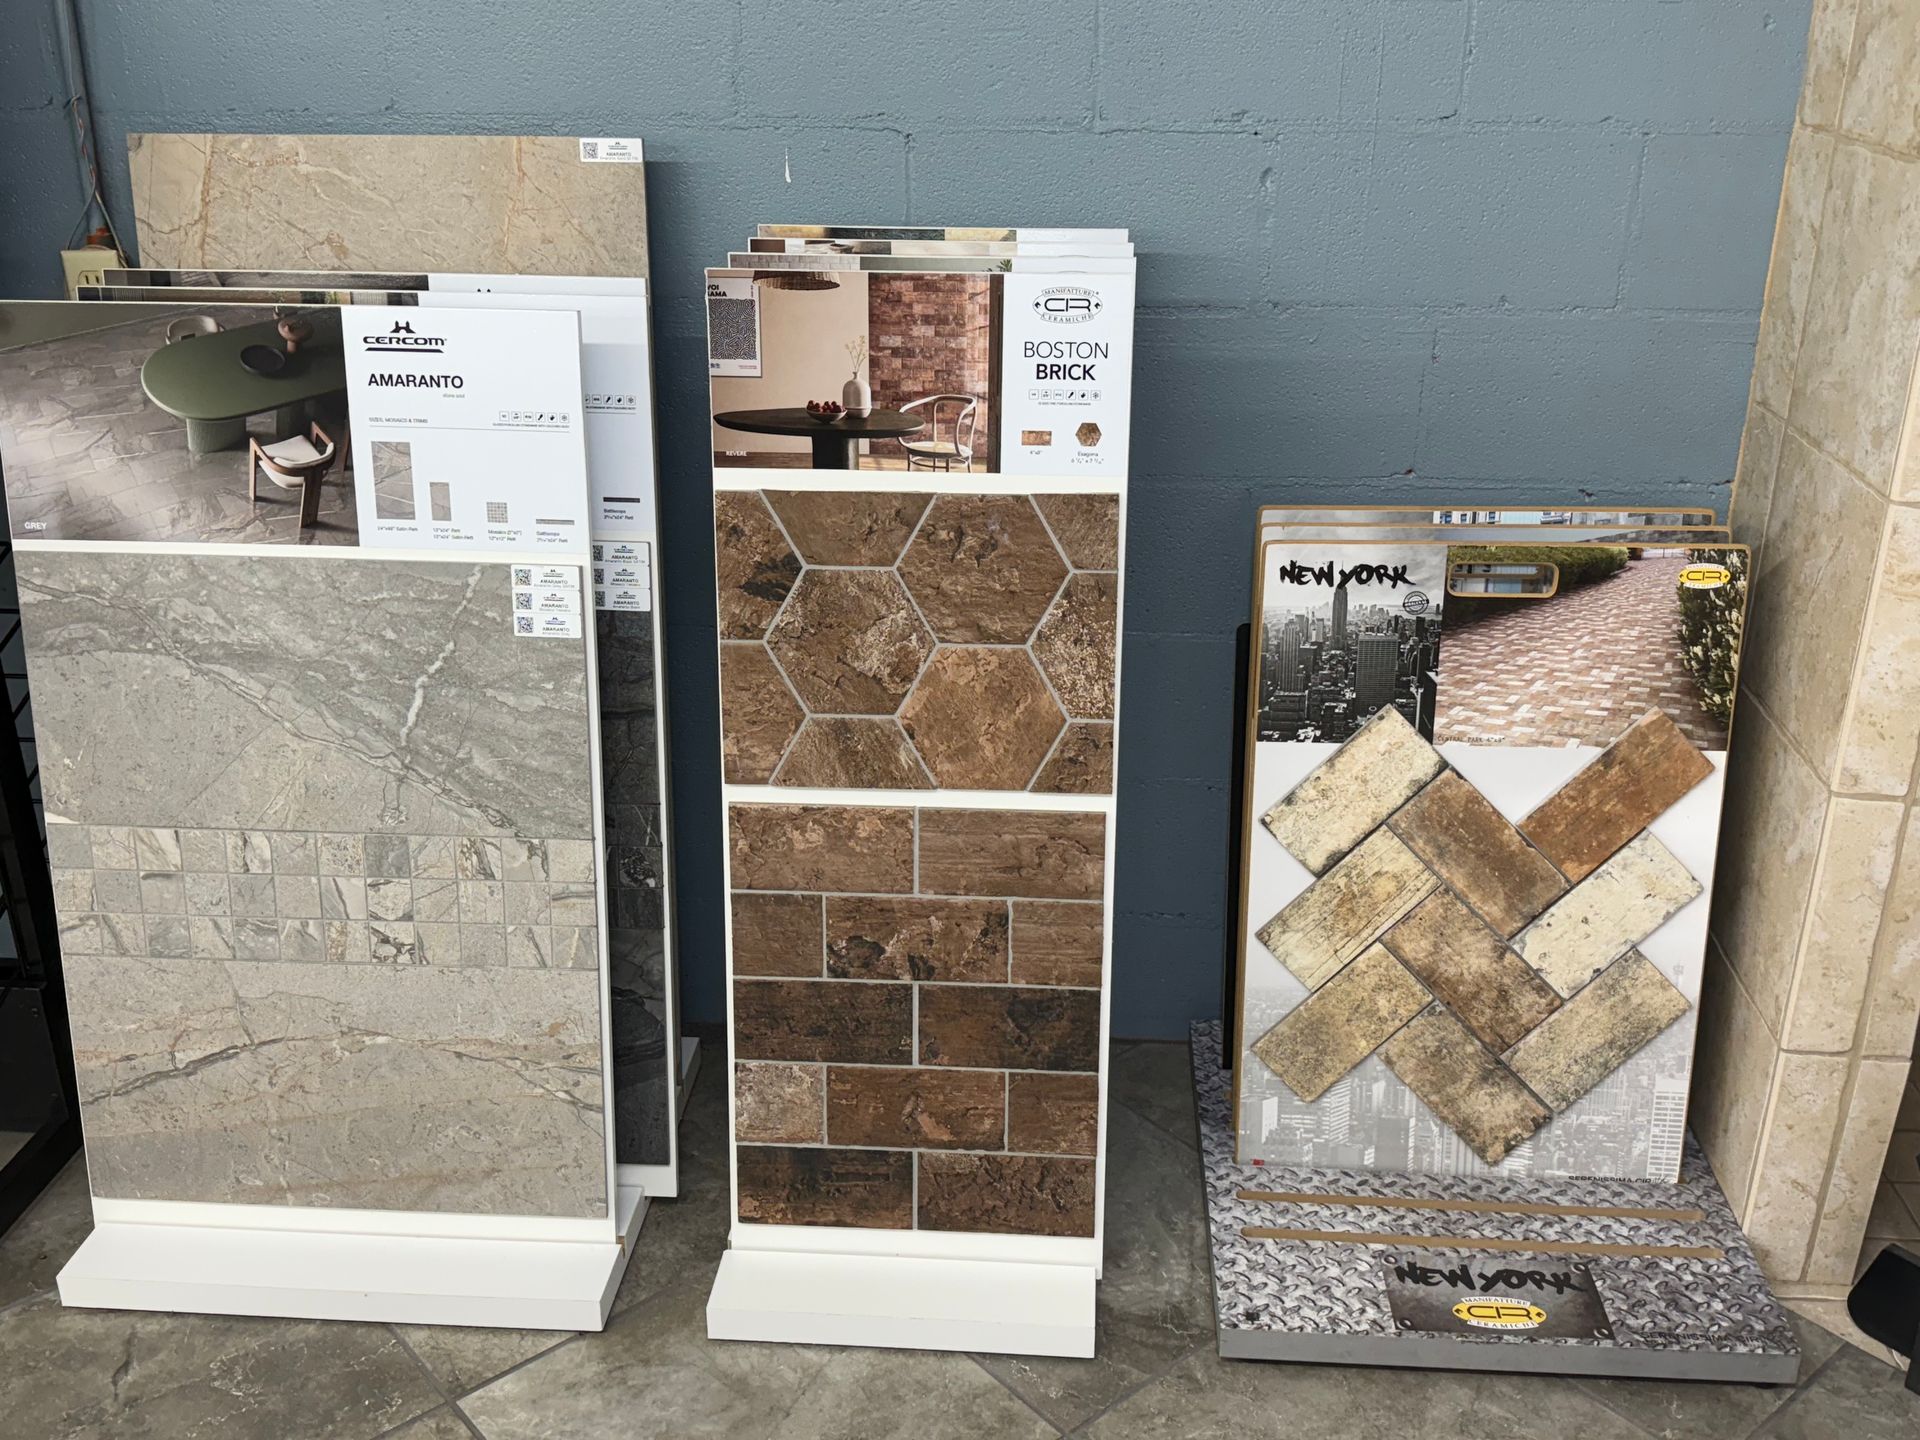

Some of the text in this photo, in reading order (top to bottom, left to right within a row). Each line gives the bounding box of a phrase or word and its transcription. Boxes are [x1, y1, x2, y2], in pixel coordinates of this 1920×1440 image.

[1044, 287, 1094, 297] MANIFATTURE
[1042, 313, 1092, 323] CERAMICHE
[362, 336, 445, 346] CERCOM
[1024, 341, 1108, 359] BOSTON
[1036, 363, 1096, 381] BRICK
[368, 373, 464, 389] AMARANTO
[24, 521, 47, 530] GREY
[1279, 560, 1416, 589] NEW YORK
[1393, 1261, 1587, 1295] NEW YORK
[1464, 1297, 1529, 1306] MANIFATTURE
[1468, 1319, 1535, 1328] CERAMICHE
